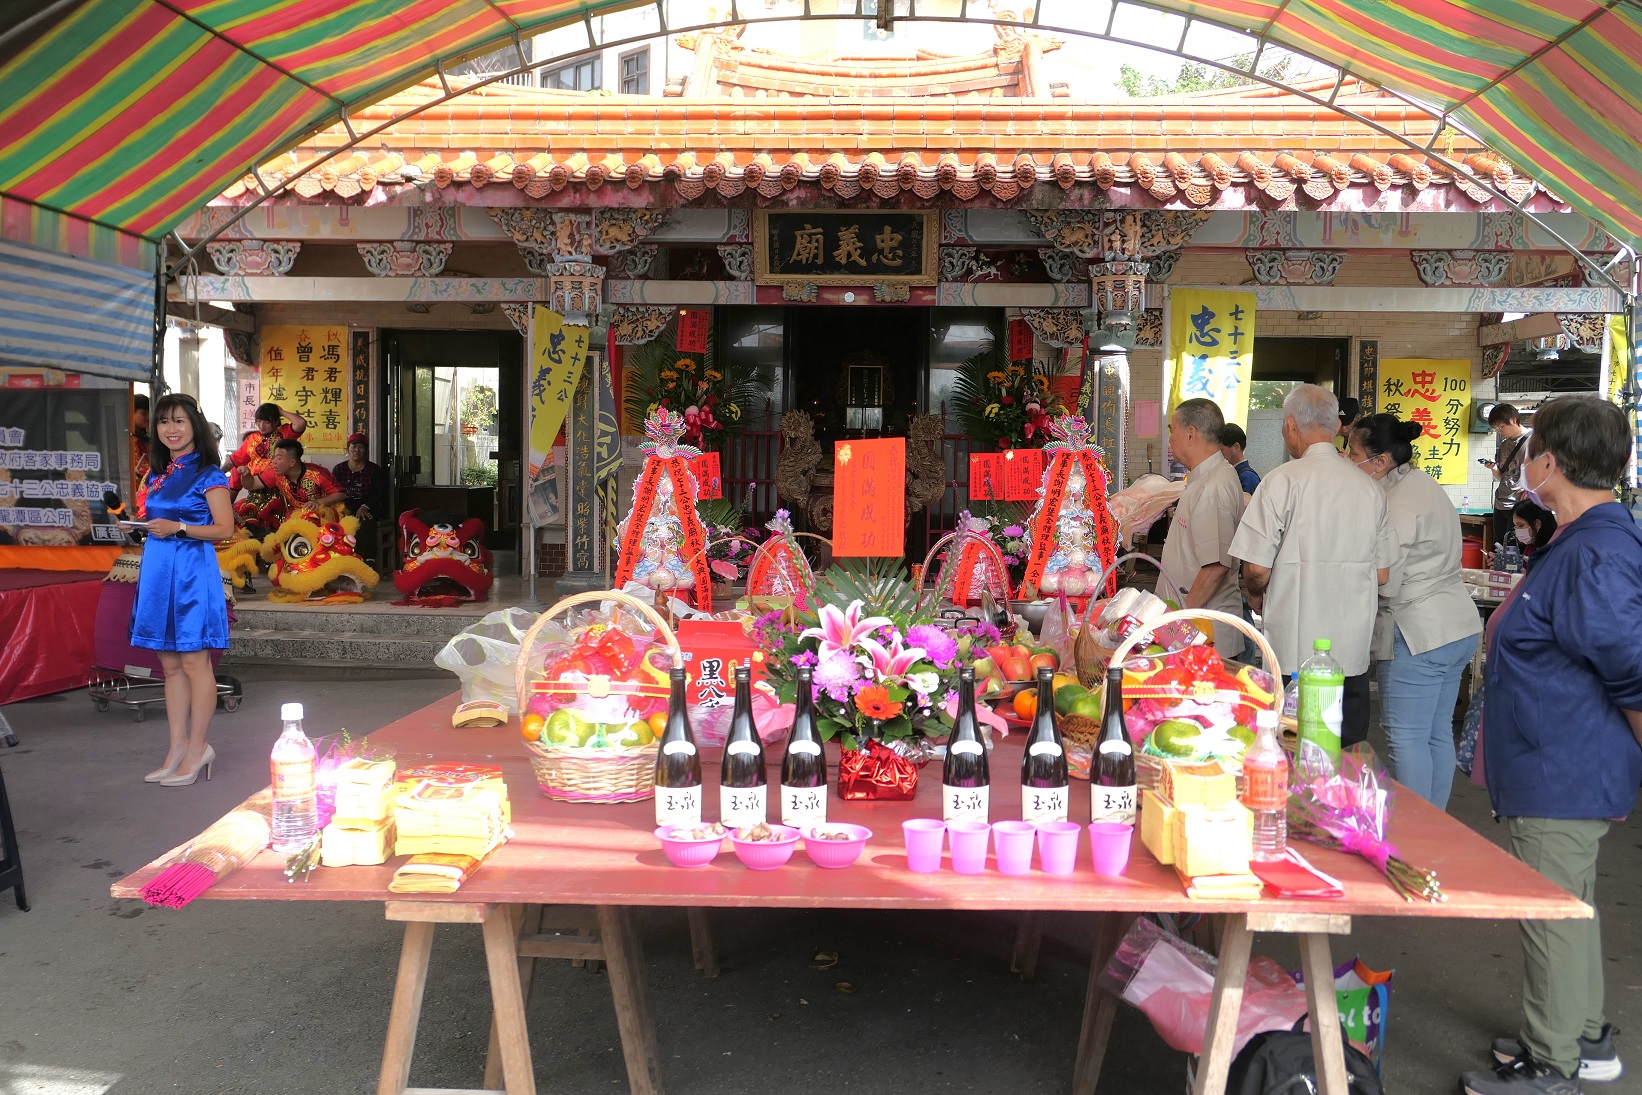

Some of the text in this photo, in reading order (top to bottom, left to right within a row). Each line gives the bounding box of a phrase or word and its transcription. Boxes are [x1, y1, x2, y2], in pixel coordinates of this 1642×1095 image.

[790, 224, 903, 266] 忠義廟
[1226, 304, 1246, 389] 七十三公
[861, 451, 877, 548] 圓滿成功
